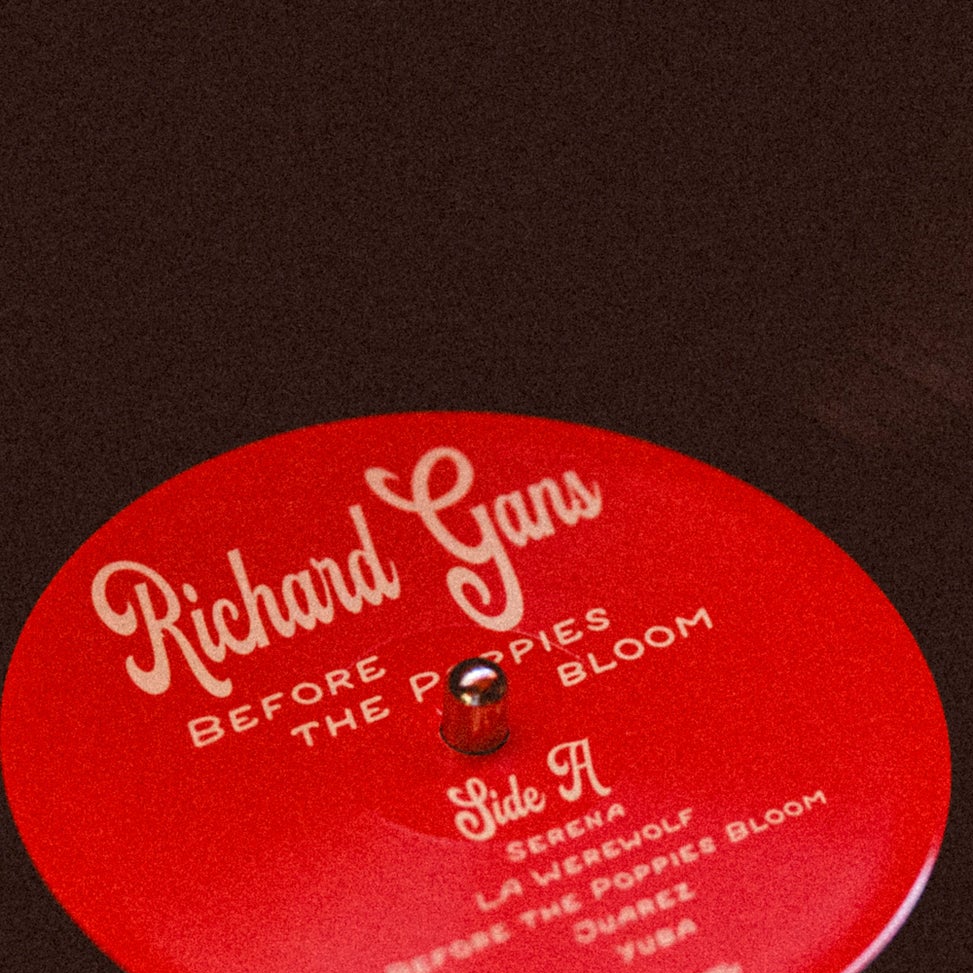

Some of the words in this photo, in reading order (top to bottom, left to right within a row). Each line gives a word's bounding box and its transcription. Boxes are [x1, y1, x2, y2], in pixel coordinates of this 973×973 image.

[92, 506, 401, 697] Richard
[364, 447, 602, 632] Gans
[290, 695, 390, 746] THE
[409, 607, 610, 703] PPIES
[556, 607, 714, 688] BLOOM
[187, 655, 386, 748] BEFORE
[446, 775, 546, 841] Side
[546, 739, 612, 801] A
[506, 803, 626, 861] SERENA
[475, 878, 523, 912] LA
[532, 807, 693, 886] WEREWOLF
[520, 893, 581, 927] THE
[591, 836, 716, 900] POPPIES
[724, 789, 828, 844] BLOOM
